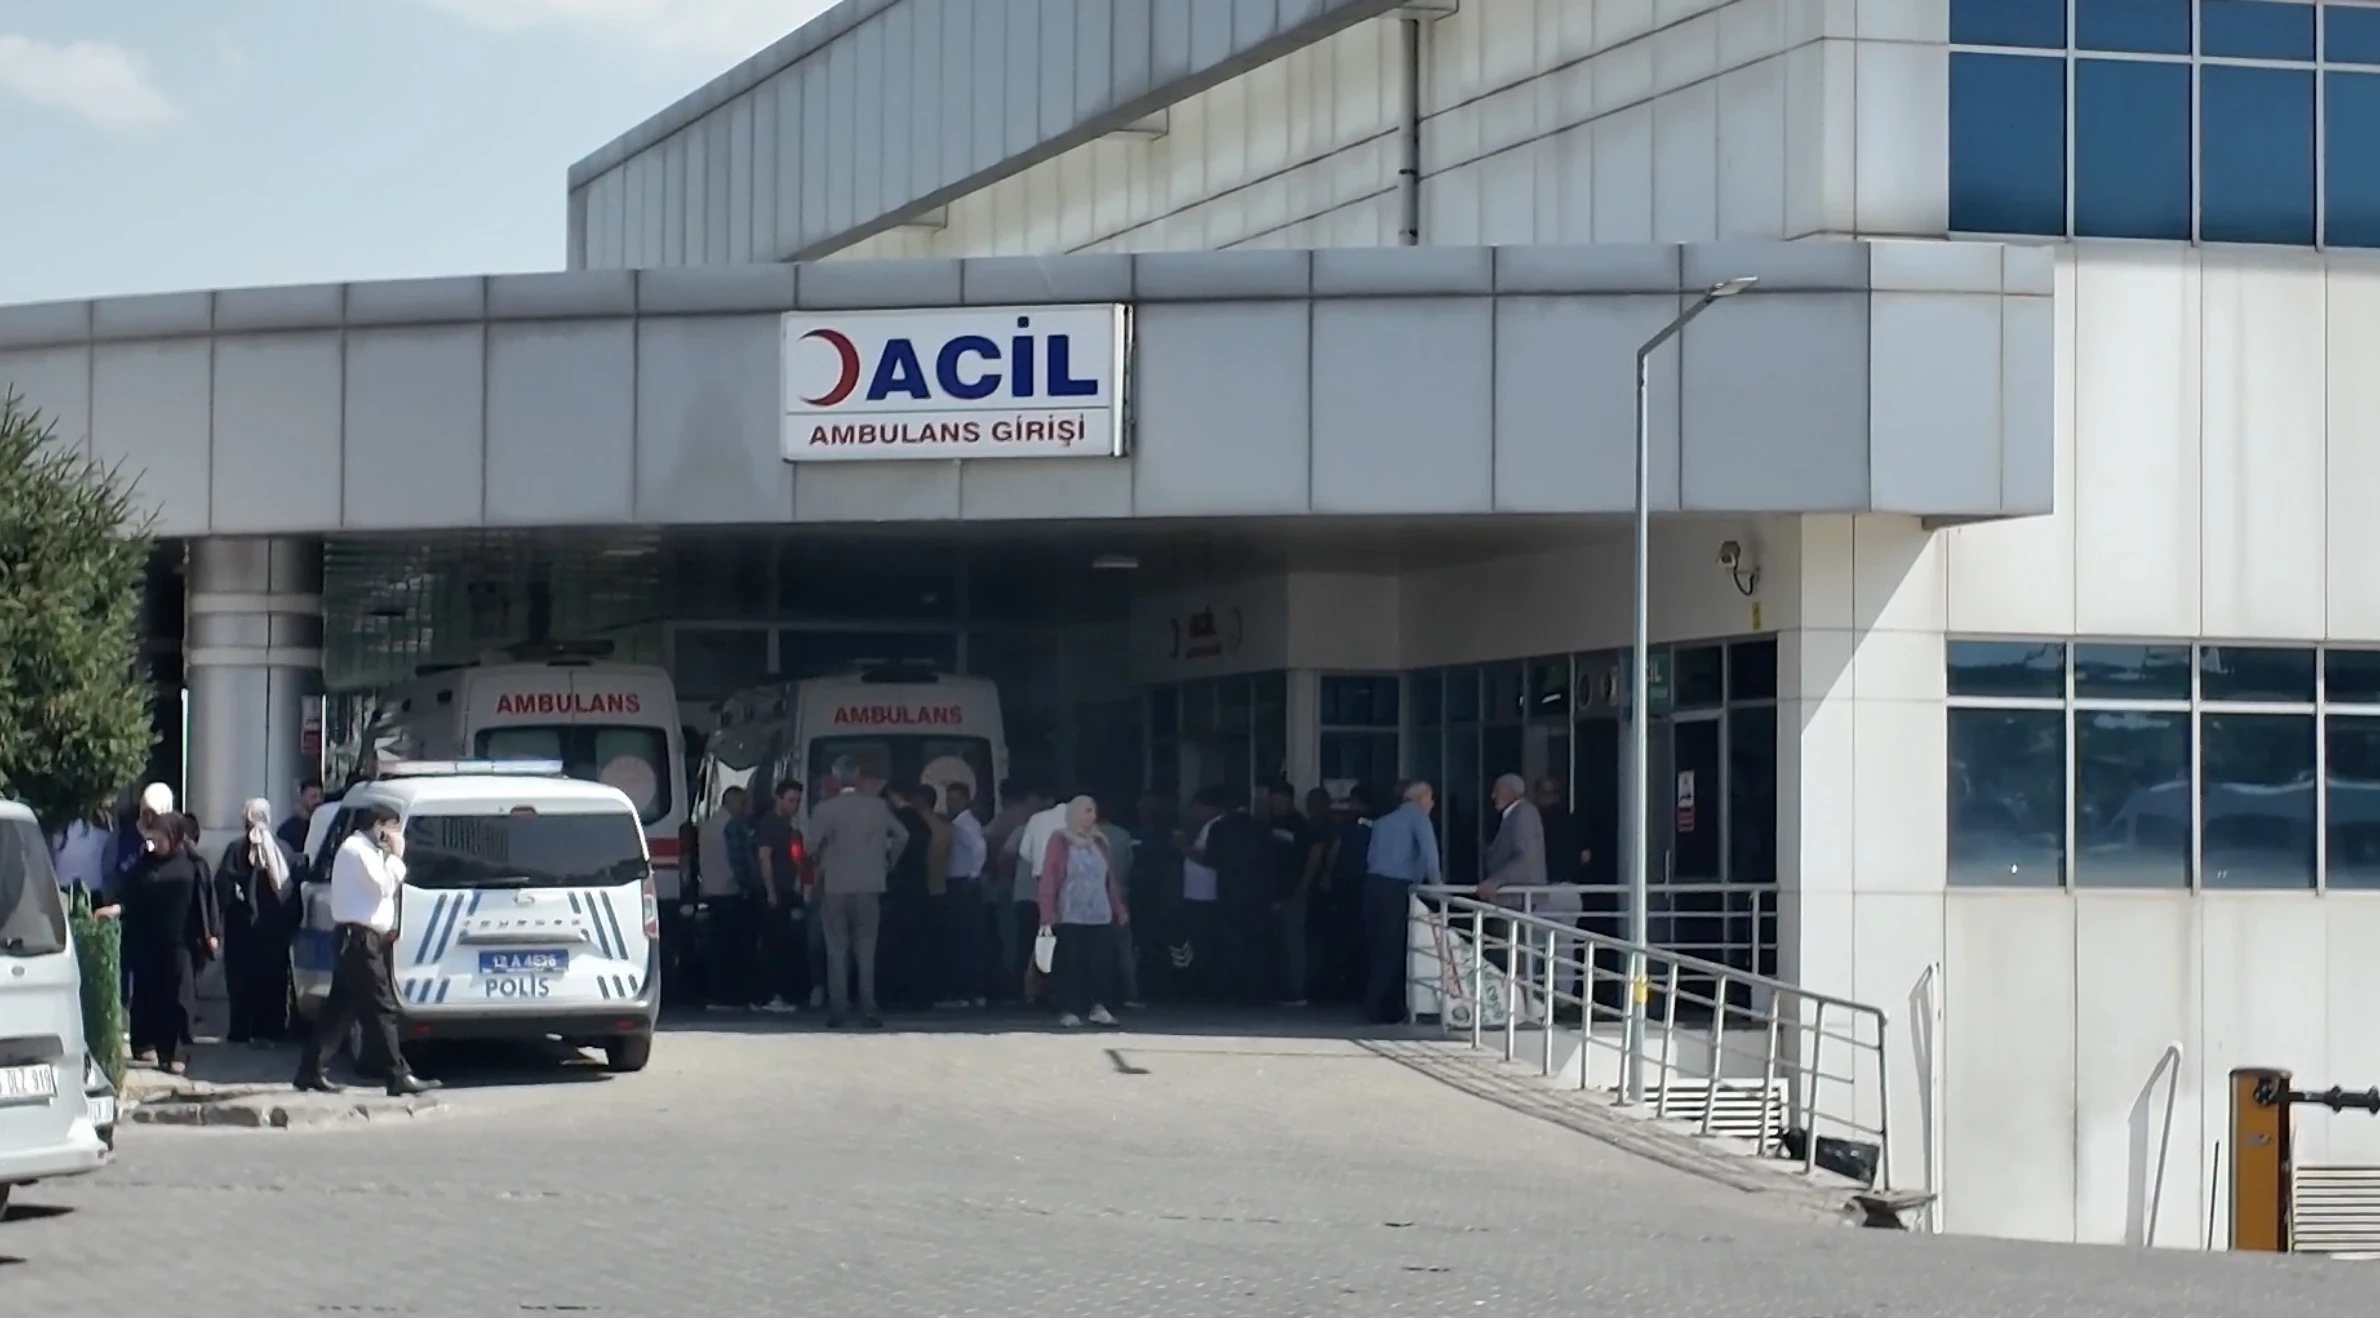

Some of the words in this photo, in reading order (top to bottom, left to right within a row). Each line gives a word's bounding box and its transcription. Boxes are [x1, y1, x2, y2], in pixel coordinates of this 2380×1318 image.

[866, 316, 1098, 400] ACİL
[809, 422, 981, 446] AMBULANS
[991, 413, 1086, 447] GİRİŞİ
[496, 692, 640, 714] AMBULANS
[834, 704, 963, 725] AMBULANS
